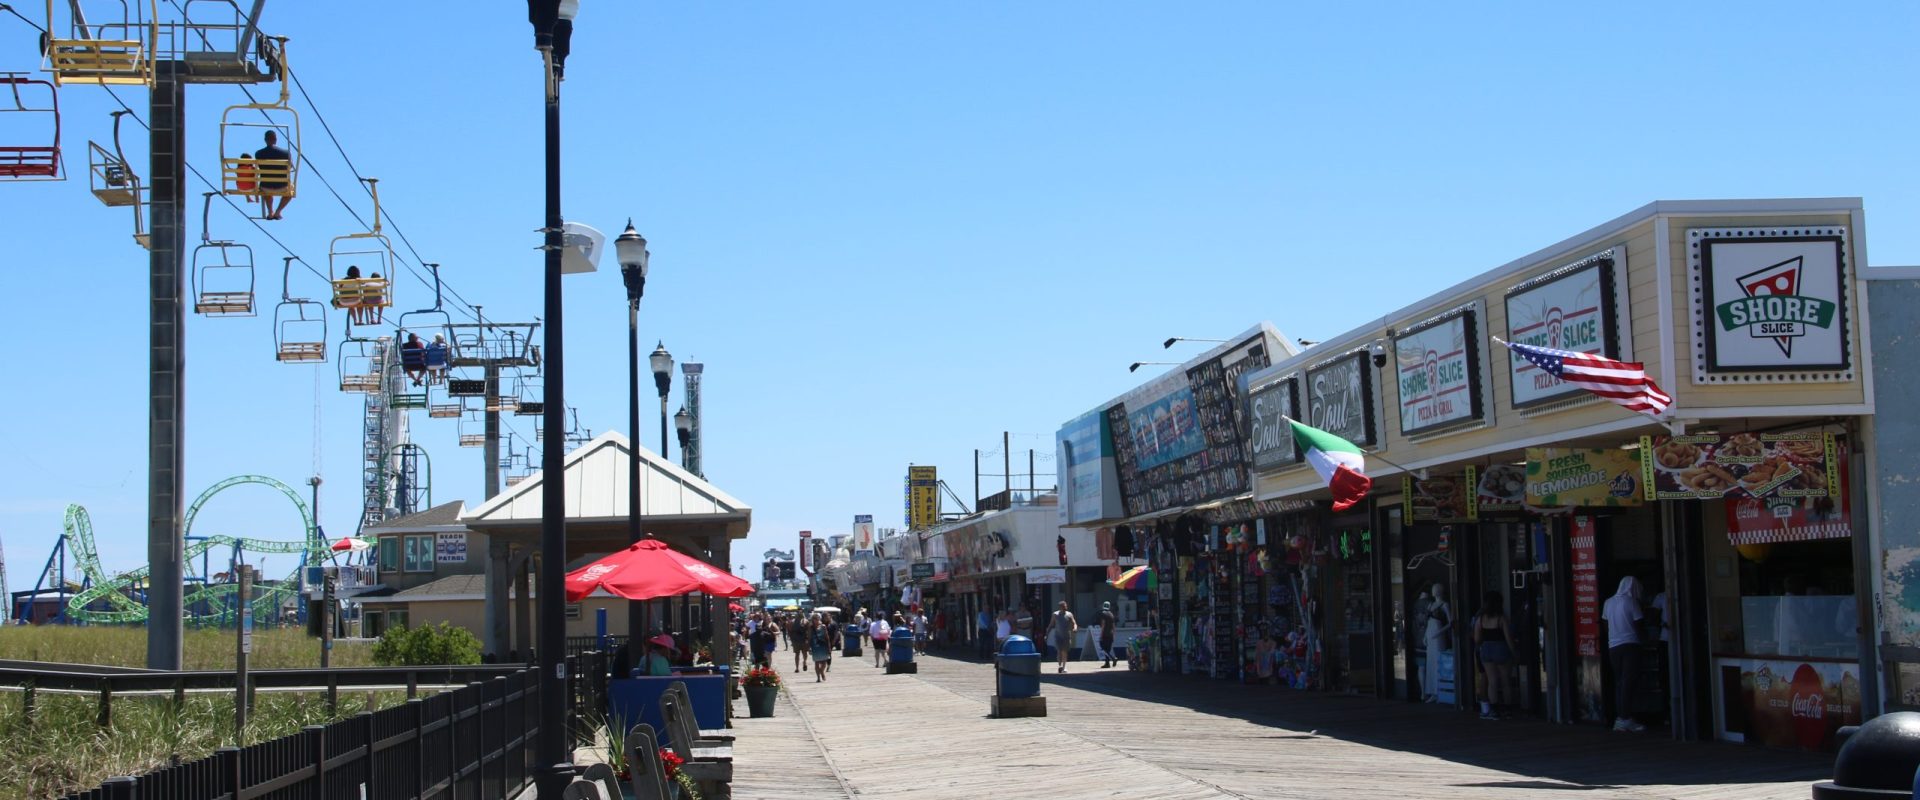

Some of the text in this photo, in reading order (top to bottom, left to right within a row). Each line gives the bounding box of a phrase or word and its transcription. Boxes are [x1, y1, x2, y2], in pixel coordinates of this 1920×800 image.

[1729, 296, 1821, 326] SHORE
[1563, 319, 1596, 349] SLICE
[1760, 322, 1794, 334] SLICE
[1402, 360, 1464, 397] SHORE SLICE
[1534, 373, 1553, 390] PIZZA
[1312, 374, 1349, 433] Soul
[1418, 405, 1433, 422] PIZZA
[1438, 400, 1453, 416] GRILL
[1252, 398, 1281, 453] Soul
[1546, 464, 1591, 482] SQUEEZED
[1549, 453, 1585, 470] FRESH
[1533, 470, 1607, 497] LEMONADE
[1792, 692, 1823, 719] Coca-Cola
